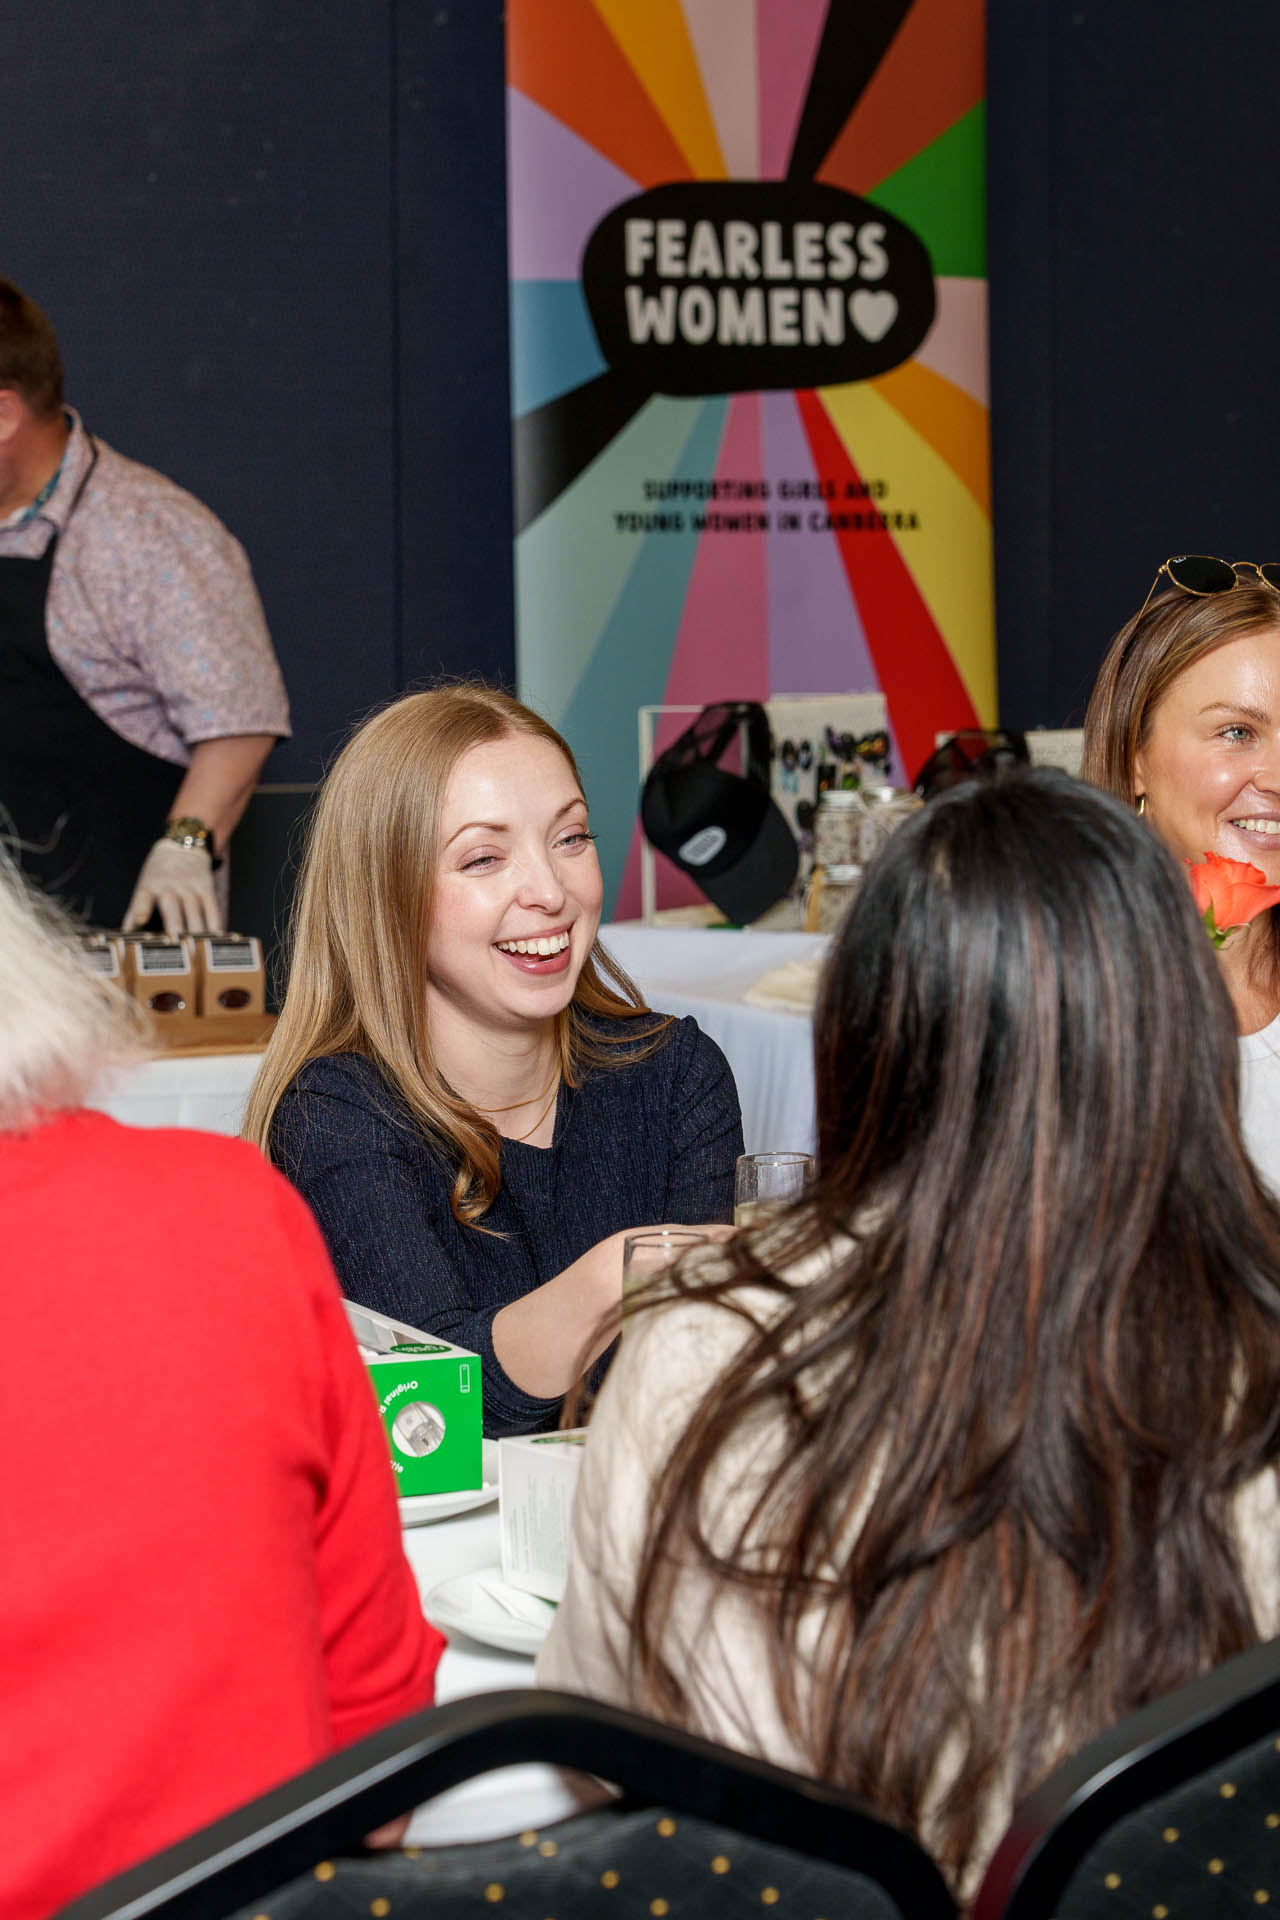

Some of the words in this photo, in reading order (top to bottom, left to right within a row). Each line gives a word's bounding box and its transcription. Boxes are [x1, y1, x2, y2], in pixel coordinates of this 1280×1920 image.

[625, 219, 889, 281] FEARLESS
[625, 285, 845, 346] WOMEN
[643, 479, 769, 500] SUPPORTING
[777, 480, 836, 500] GIRLS
[845, 480, 889, 500] AND
[614, 510, 686, 532] YOUNG
[693, 511, 769, 532] WOMEN
[777, 512, 802, 532] IN
[810, 512, 920, 532] CANBERRA
[384, 1381, 419, 1406] Original
